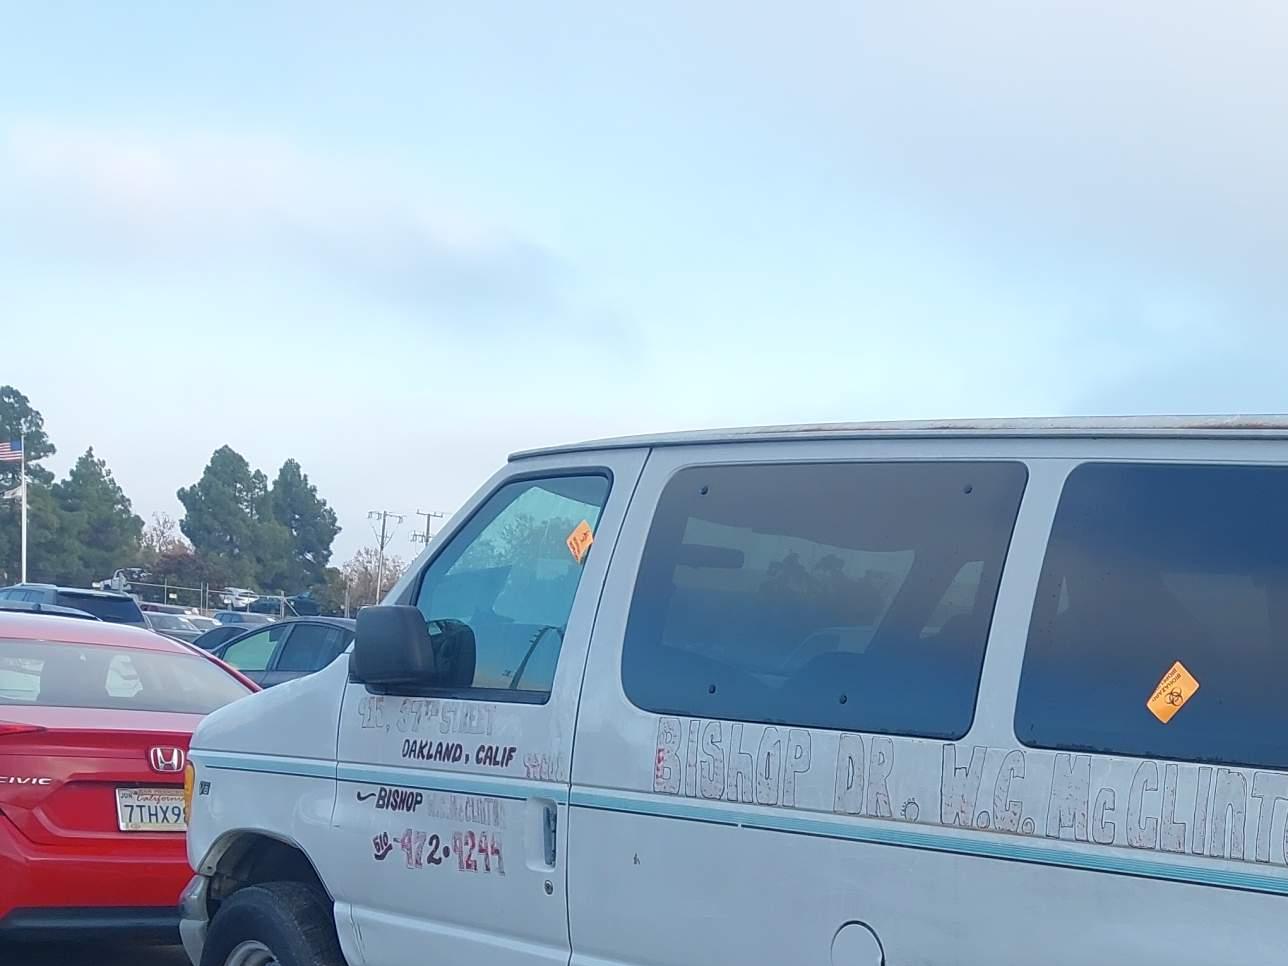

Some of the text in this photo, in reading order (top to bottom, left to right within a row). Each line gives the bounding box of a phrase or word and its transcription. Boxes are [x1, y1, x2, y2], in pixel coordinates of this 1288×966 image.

[475, 744, 518, 768] CALIF
[0, 776, 52, 785] IVIC
[375, 787, 423, 813] BISHOP
[123, 804, 188, 824] 7THX9
